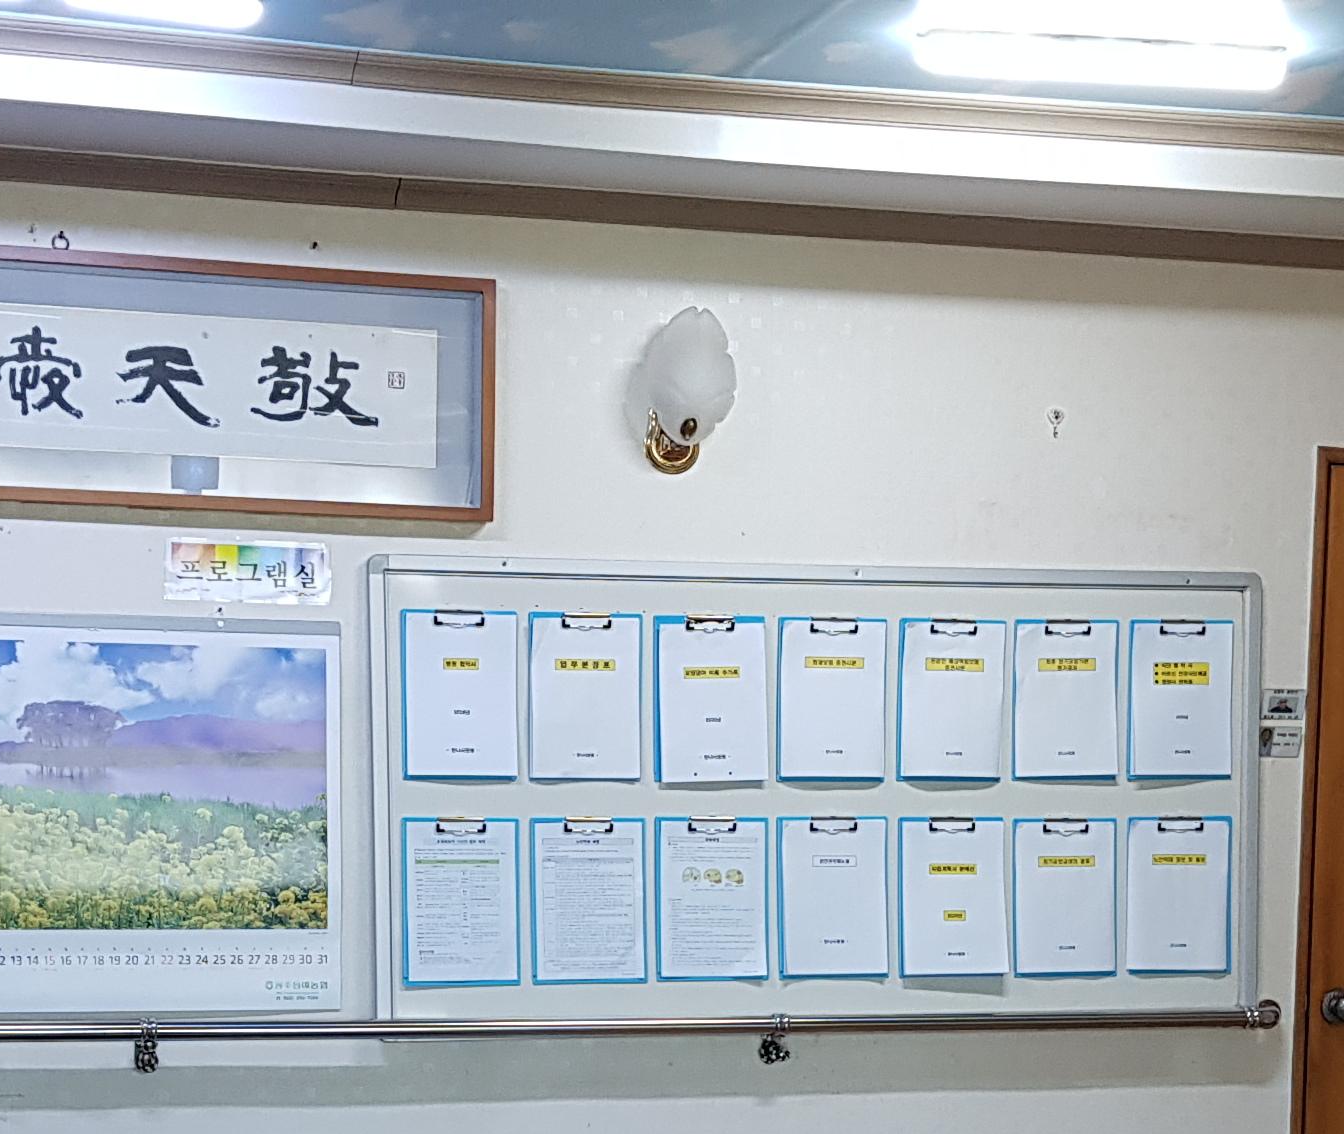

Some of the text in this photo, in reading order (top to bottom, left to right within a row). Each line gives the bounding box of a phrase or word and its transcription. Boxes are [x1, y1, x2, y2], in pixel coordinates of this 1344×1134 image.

[11, 956, 22, 966] 13
[27, 956, 39, 966] 14
[45, 956, 56, 966] 15
[60, 956, 72, 966] 16
[77, 956, 88, 966] 17
[93, 956, 104, 966] 18
[109, 955, 120, 965] 19
[125, 955, 138, 965] 20
[144, 955, 155, 965] 21
[161, 955, 173, 965] 22
[178, 955, 191, 965] 23
[196, 955, 208, 965] 24
[213, 955, 226, 965] 25
[230, 955, 243, 965] 26
[248, 955, 260, 965] 27
[265, 955, 278, 965] 28
[282, 954, 295, 964] 29
[299, 954, 312, 964] 30
[317, 954, 328, 964] 31
